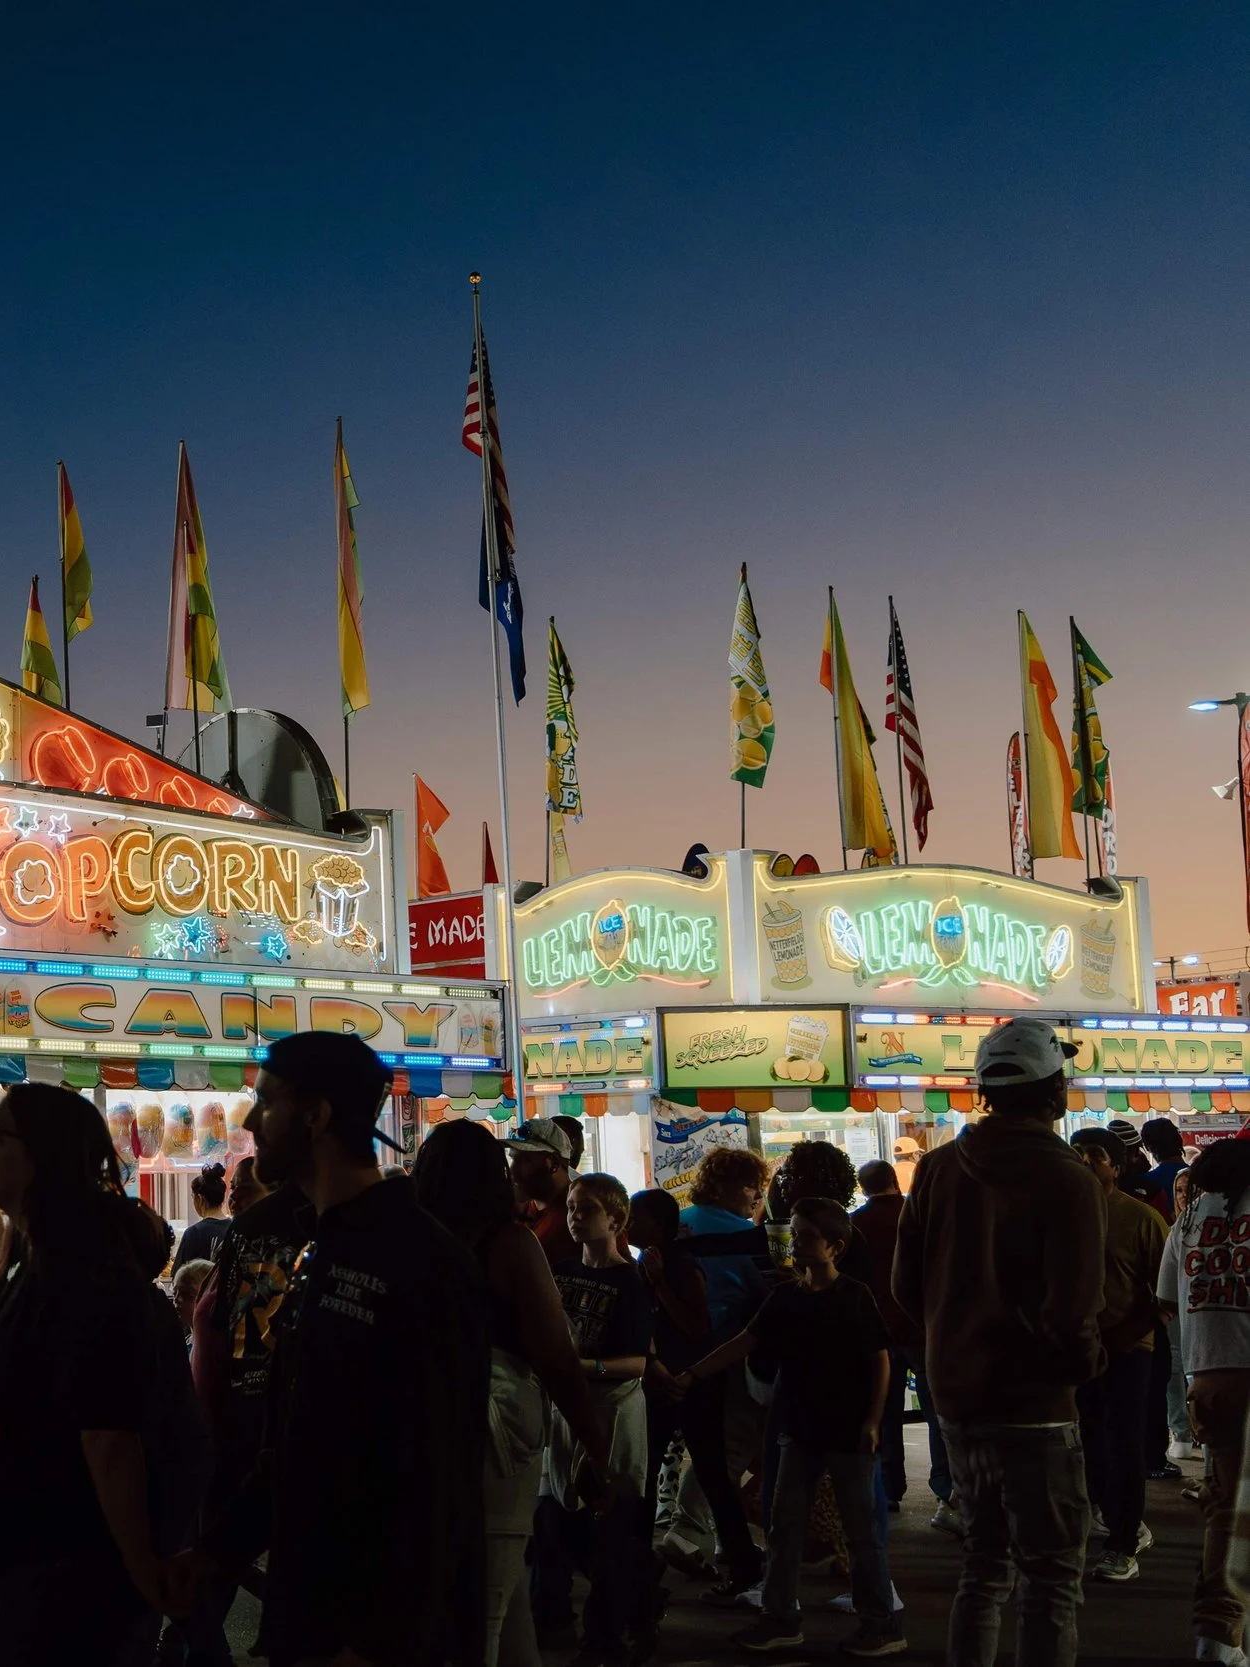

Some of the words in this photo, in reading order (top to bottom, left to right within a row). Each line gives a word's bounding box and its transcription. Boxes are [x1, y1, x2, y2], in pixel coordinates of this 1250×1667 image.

[597, 914, 624, 933] ICE
[935, 916, 963, 934] ICE
[34, 982, 458, 1048] CANDY
[689, 1024, 748, 1050] FRESH
[526, 1037, 644, 1079] NADE
[673, 1037, 769, 1070] SQUEEZED
